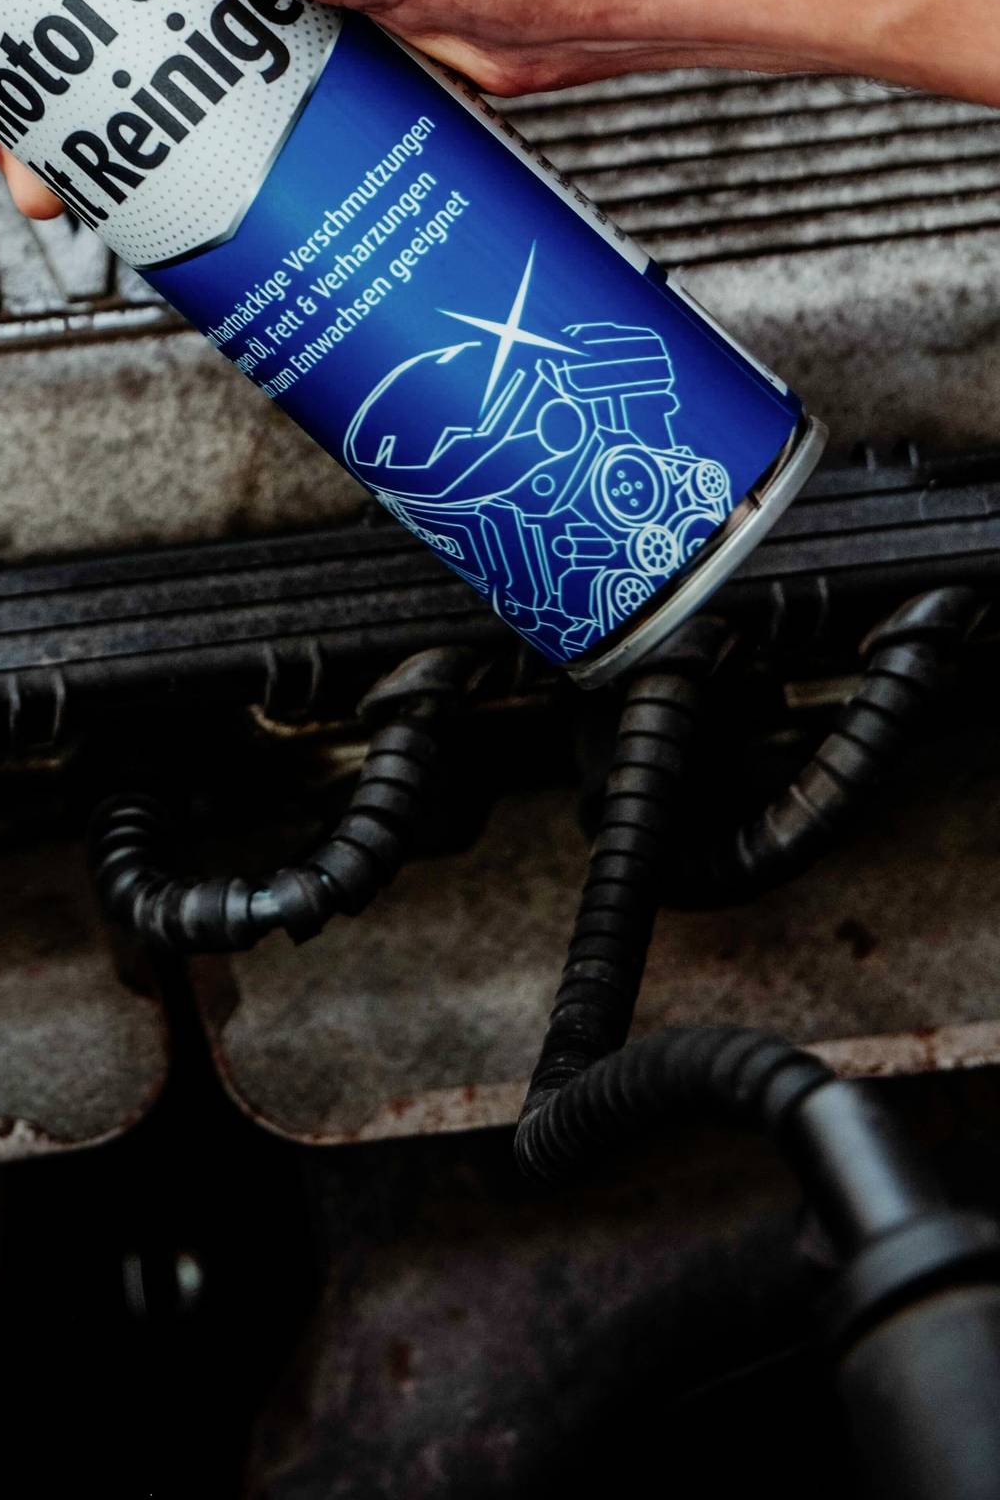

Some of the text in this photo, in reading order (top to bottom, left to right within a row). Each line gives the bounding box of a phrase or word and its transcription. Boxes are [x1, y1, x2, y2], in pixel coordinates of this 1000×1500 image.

[208, 115, 435, 344] hartnäckige Verschmutzungen
[265, 309, 304, 345] Fett
[296, 295, 318, 316] &
[310, 172, 437, 301] Verharzungen
[270, 368, 299, 393] zum
[289, 275, 392, 374] Entwachsen
[389, 190, 470, 283] geeignet
